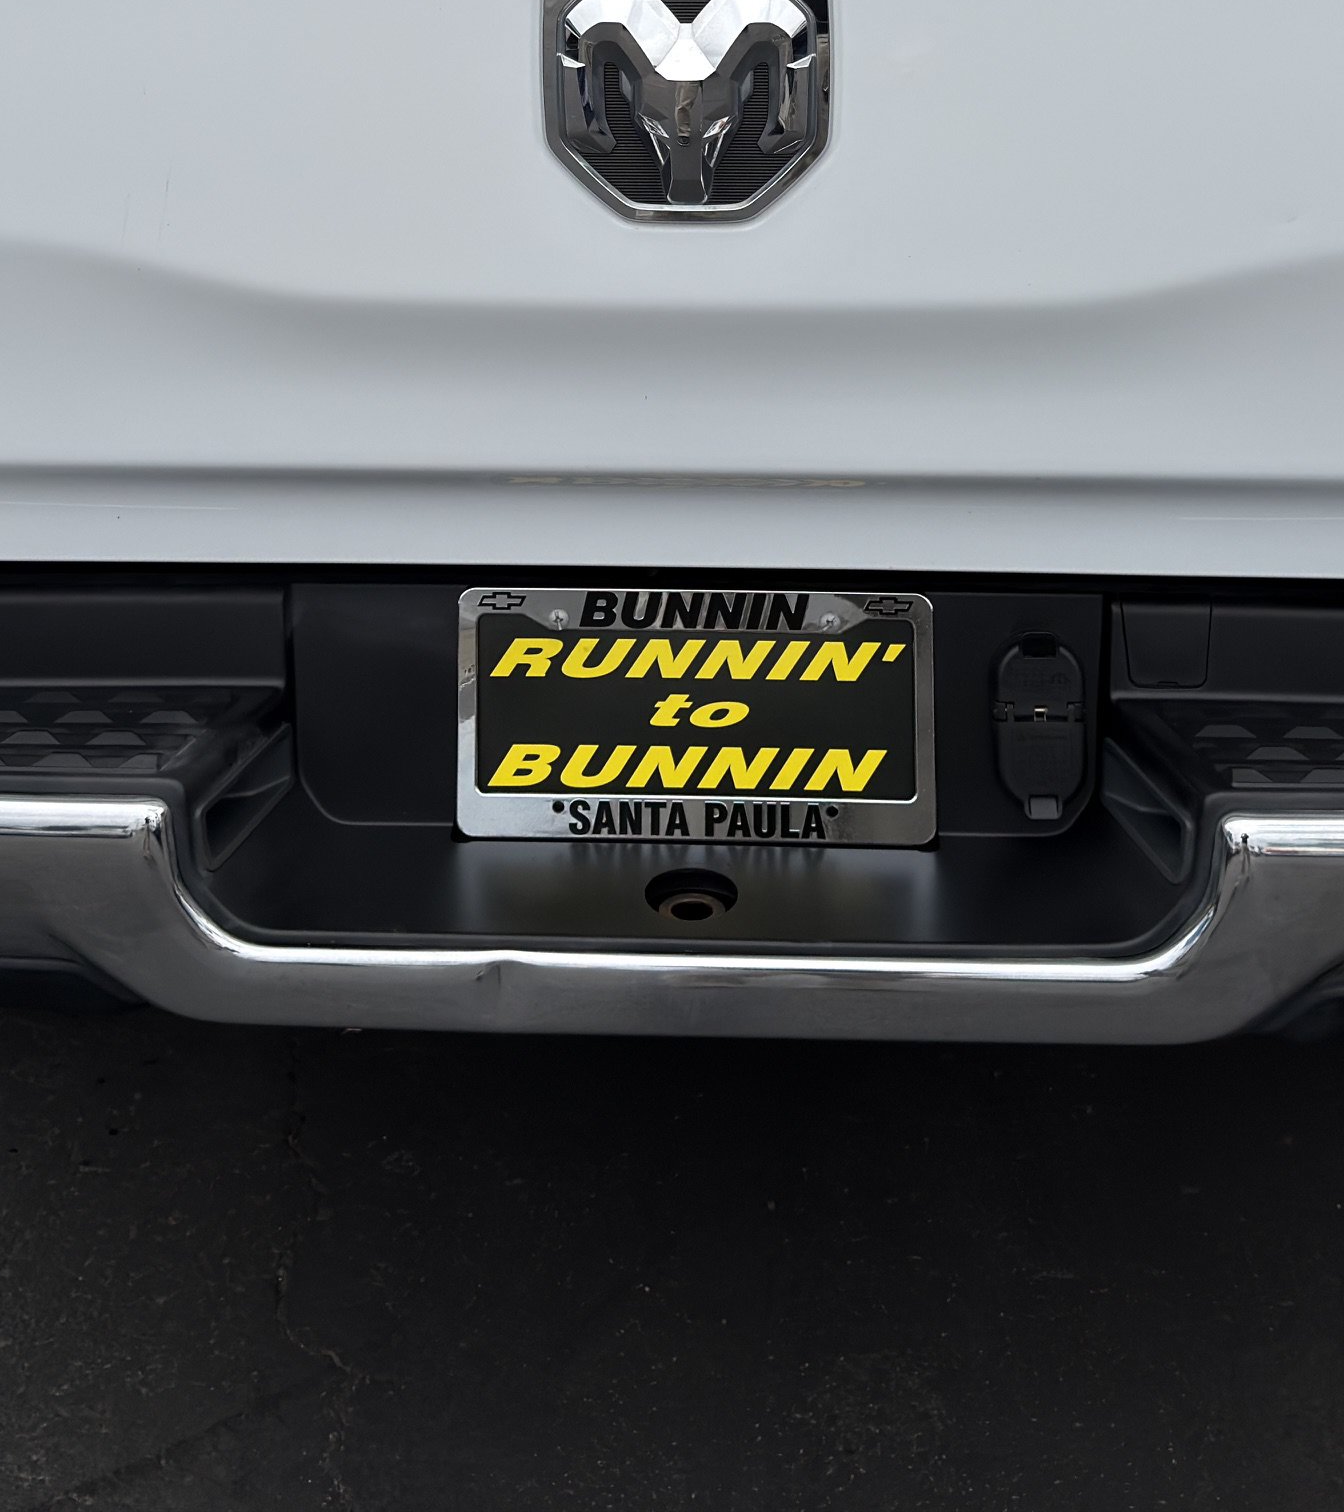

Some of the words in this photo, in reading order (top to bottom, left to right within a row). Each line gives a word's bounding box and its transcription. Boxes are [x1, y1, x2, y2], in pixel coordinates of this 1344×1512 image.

[579, 591, 810, 631] BUNNIN
[490, 638, 906, 682] RUNNIN'
[649, 694, 750, 728] to
[487, 744, 887, 792] BUNNIN
[568, 800, 692, 837] SANTA
[704, 802, 826, 840] PAULA
